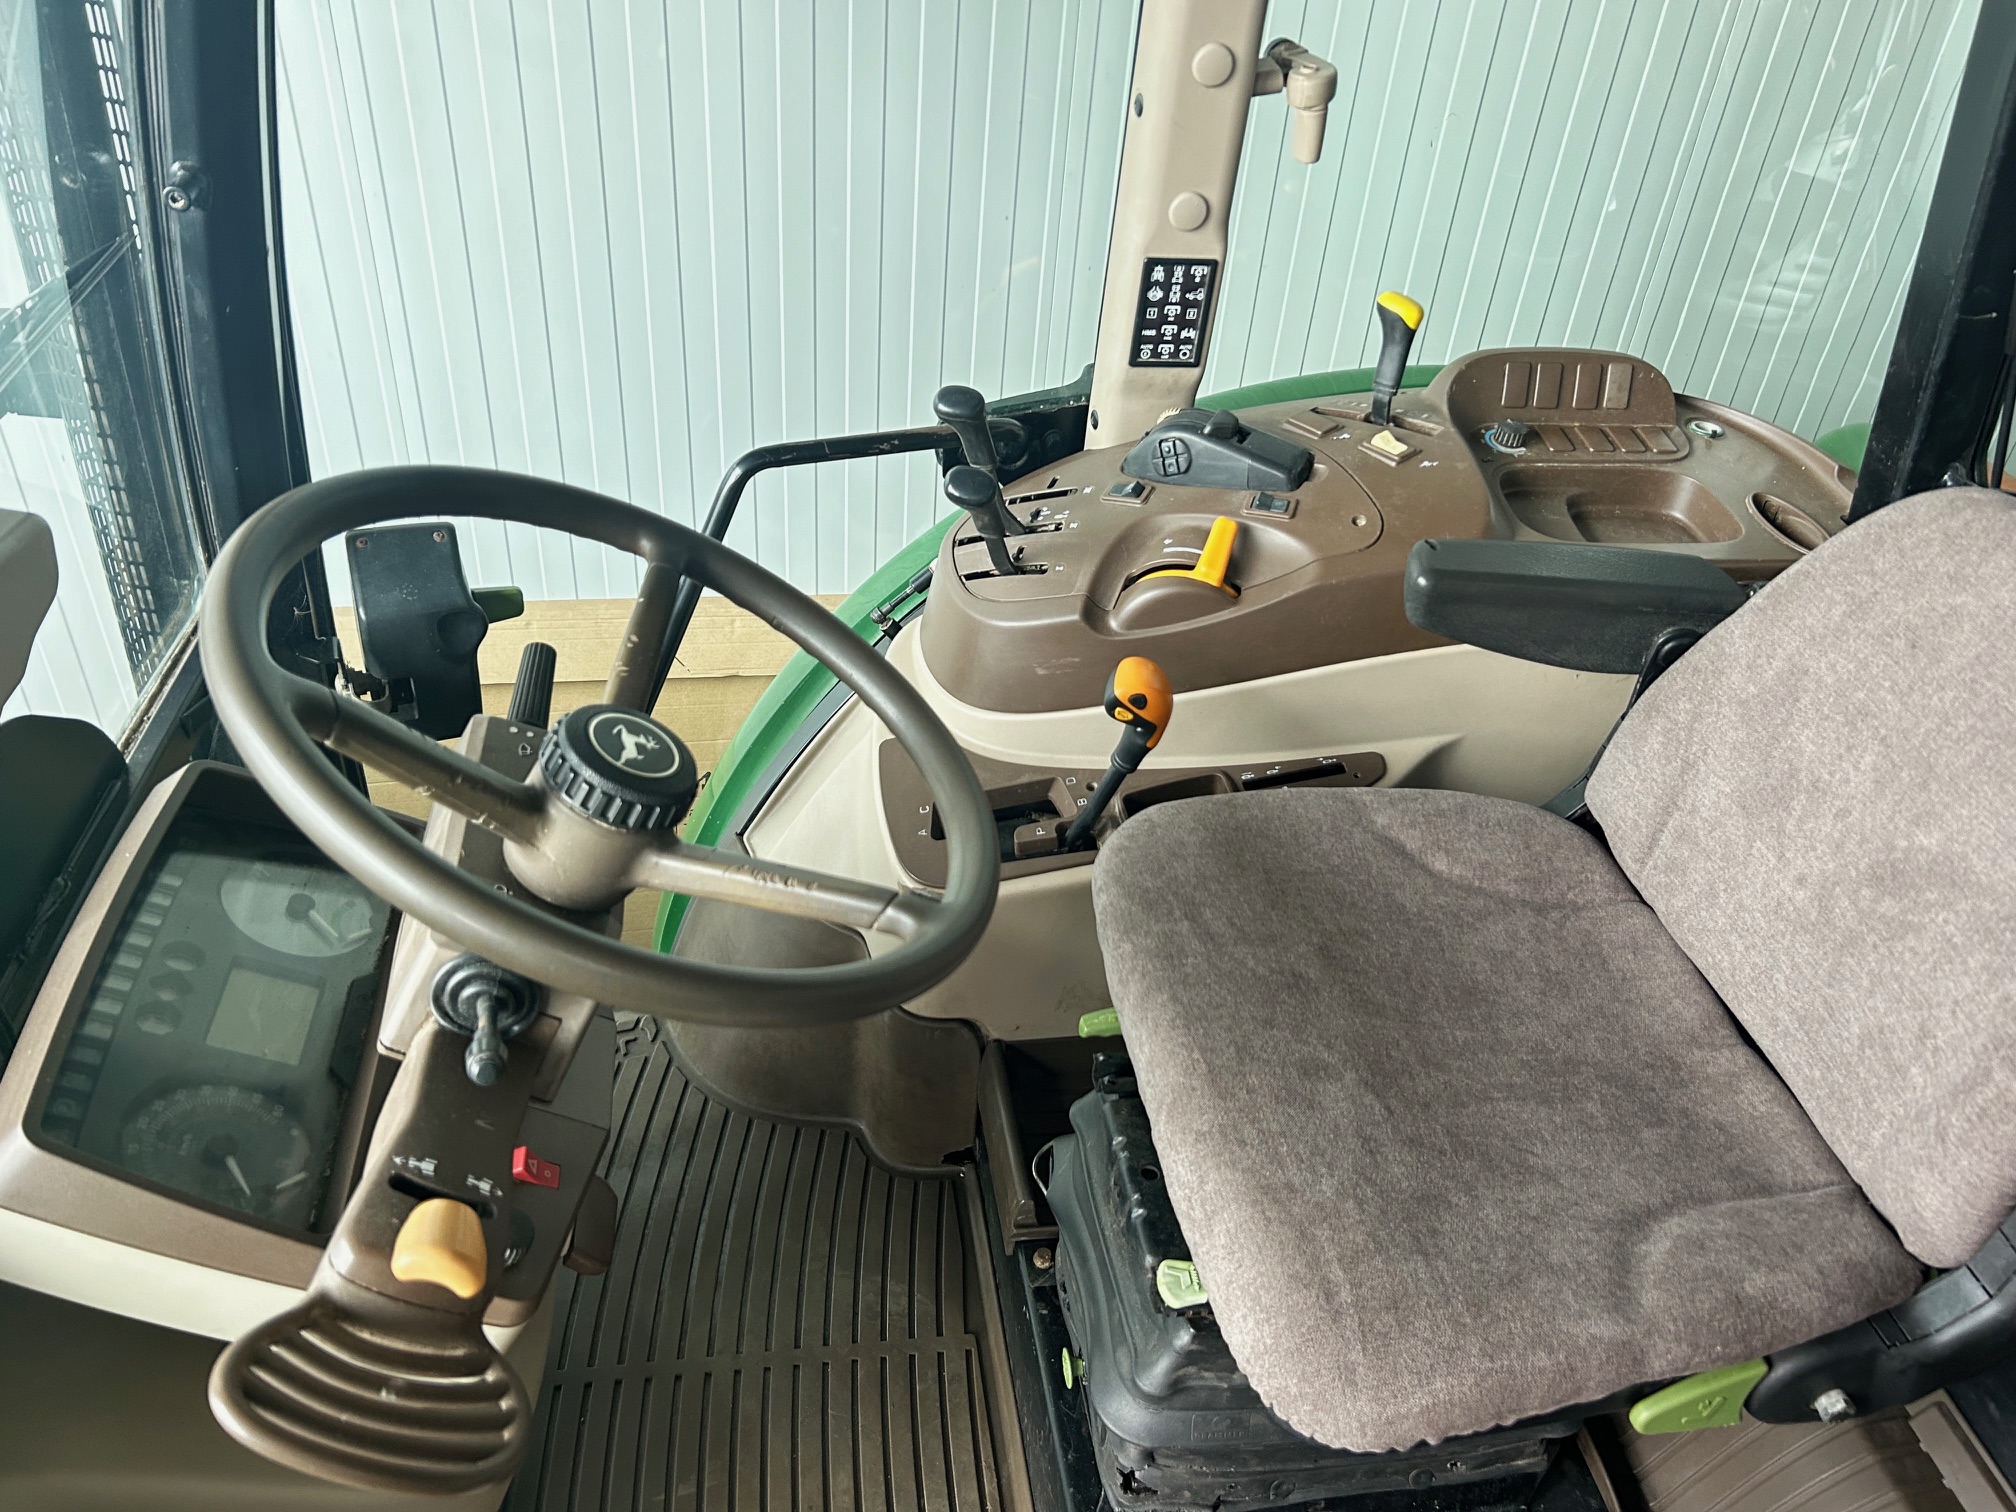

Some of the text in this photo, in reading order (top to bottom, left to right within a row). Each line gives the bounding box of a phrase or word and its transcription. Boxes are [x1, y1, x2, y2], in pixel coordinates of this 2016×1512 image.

[1065, 776, 1077, 786] D
[1077, 797, 1088, 806] B
[919, 805, 930, 814] C
[917, 828, 928, 836] A
[1035, 827, 1046, 835] P
